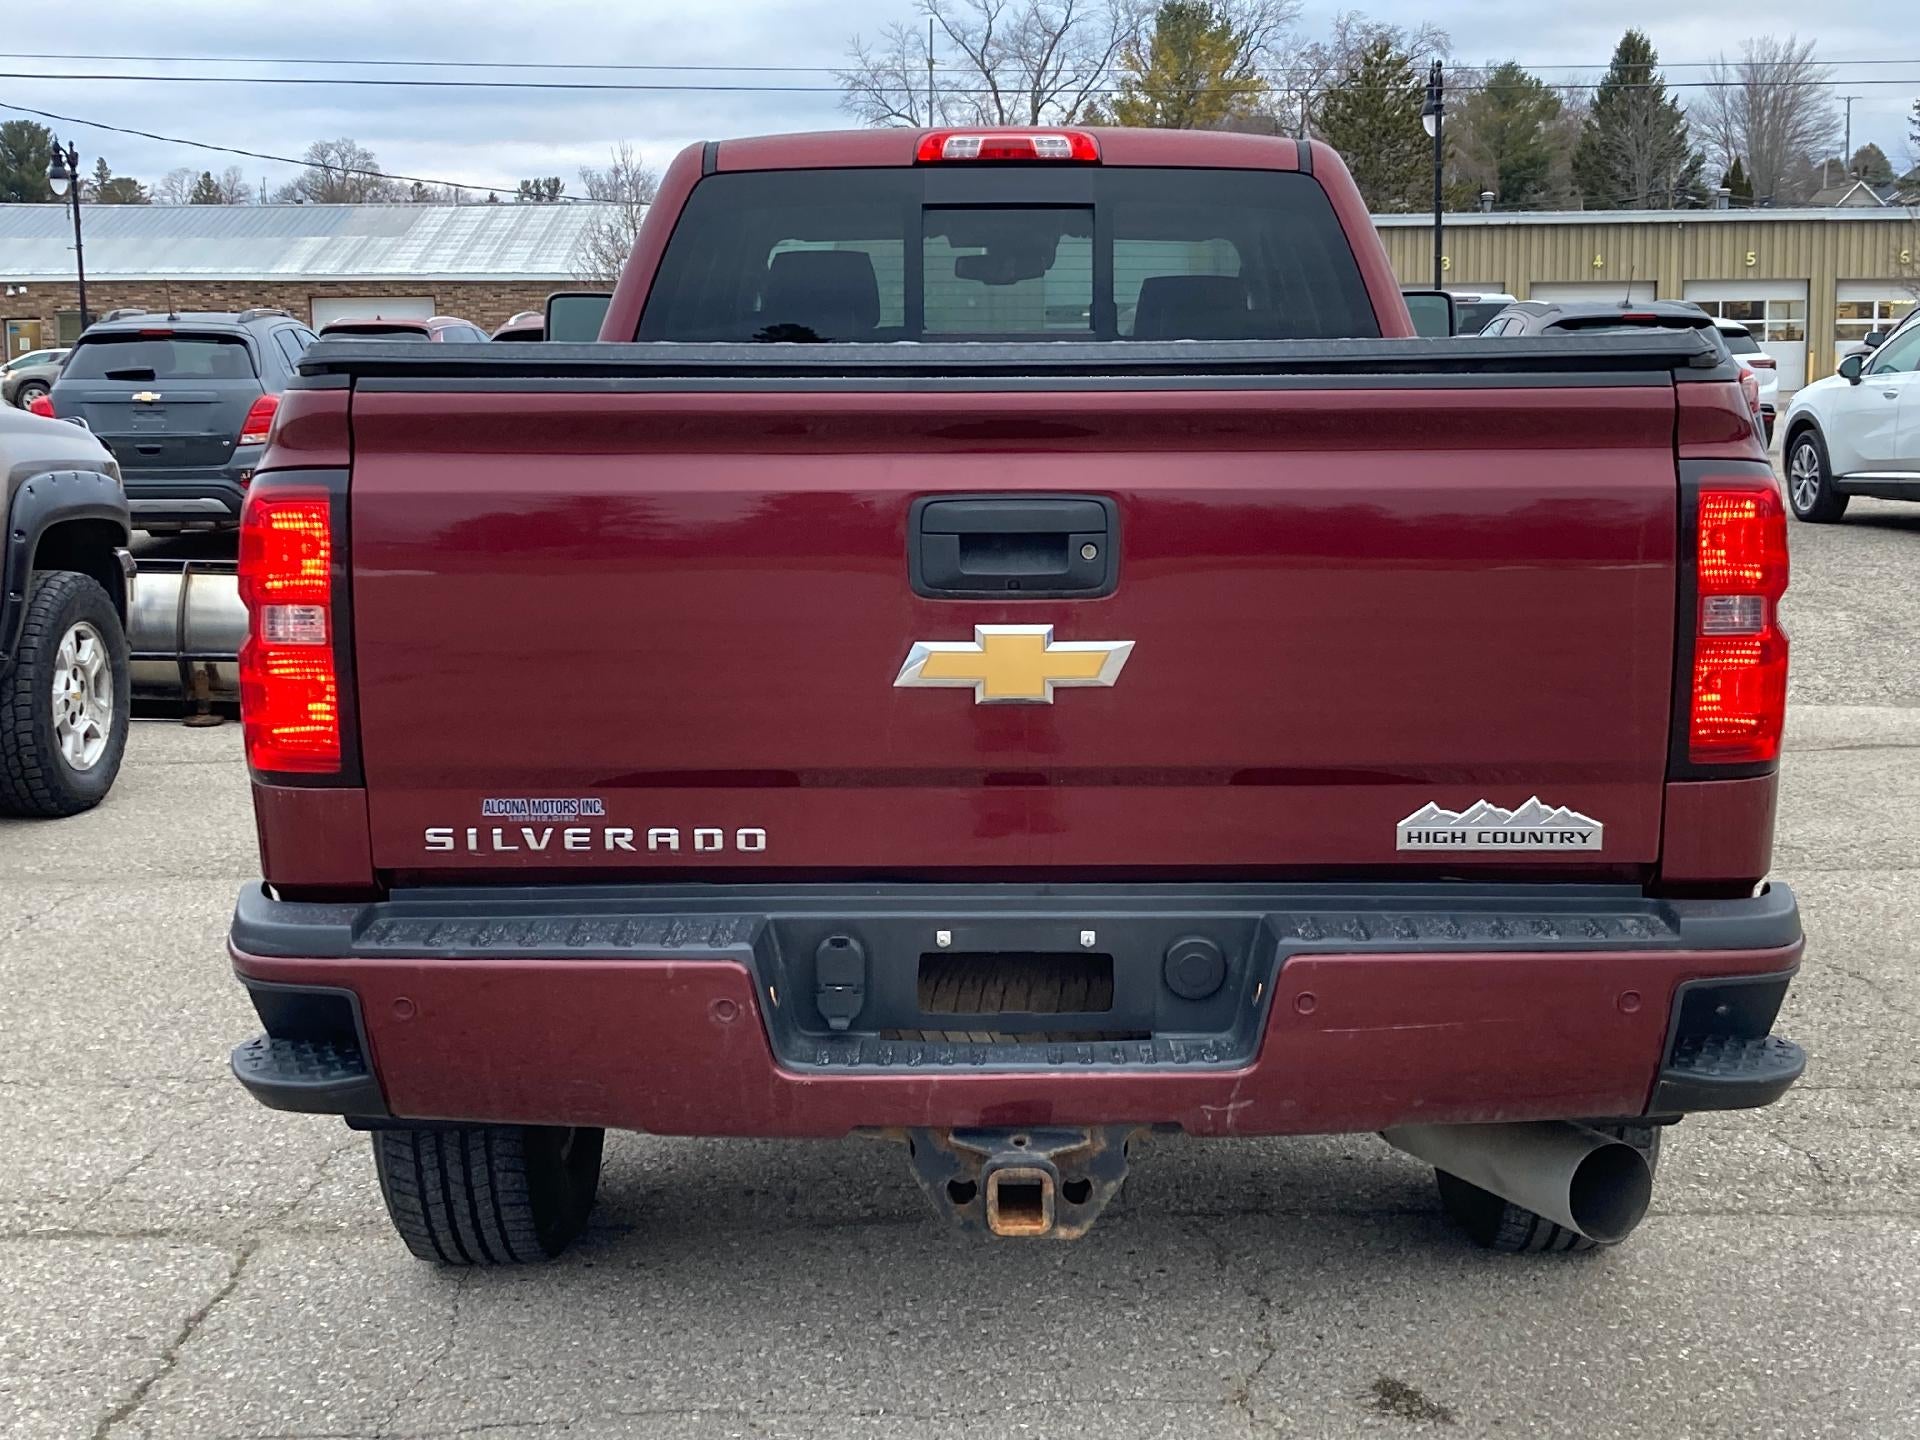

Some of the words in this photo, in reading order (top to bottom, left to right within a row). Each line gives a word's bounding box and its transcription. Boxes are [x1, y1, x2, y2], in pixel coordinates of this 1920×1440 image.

[1440, 256, 1451, 270] 3
[1592, 254, 1604, 268] 4
[1745, 251, 1756, 266] 5
[1900, 250, 1910, 264] 6
[483, 798, 529, 816] ALCONA
[530, 798, 579, 815] MOTORS
[580, 798, 605, 815] INC.
[425, 827, 767, 851] SILVERADO
[1406, 830, 1467, 845] HIGH
[1476, 830, 1594, 845] COUNTRY
